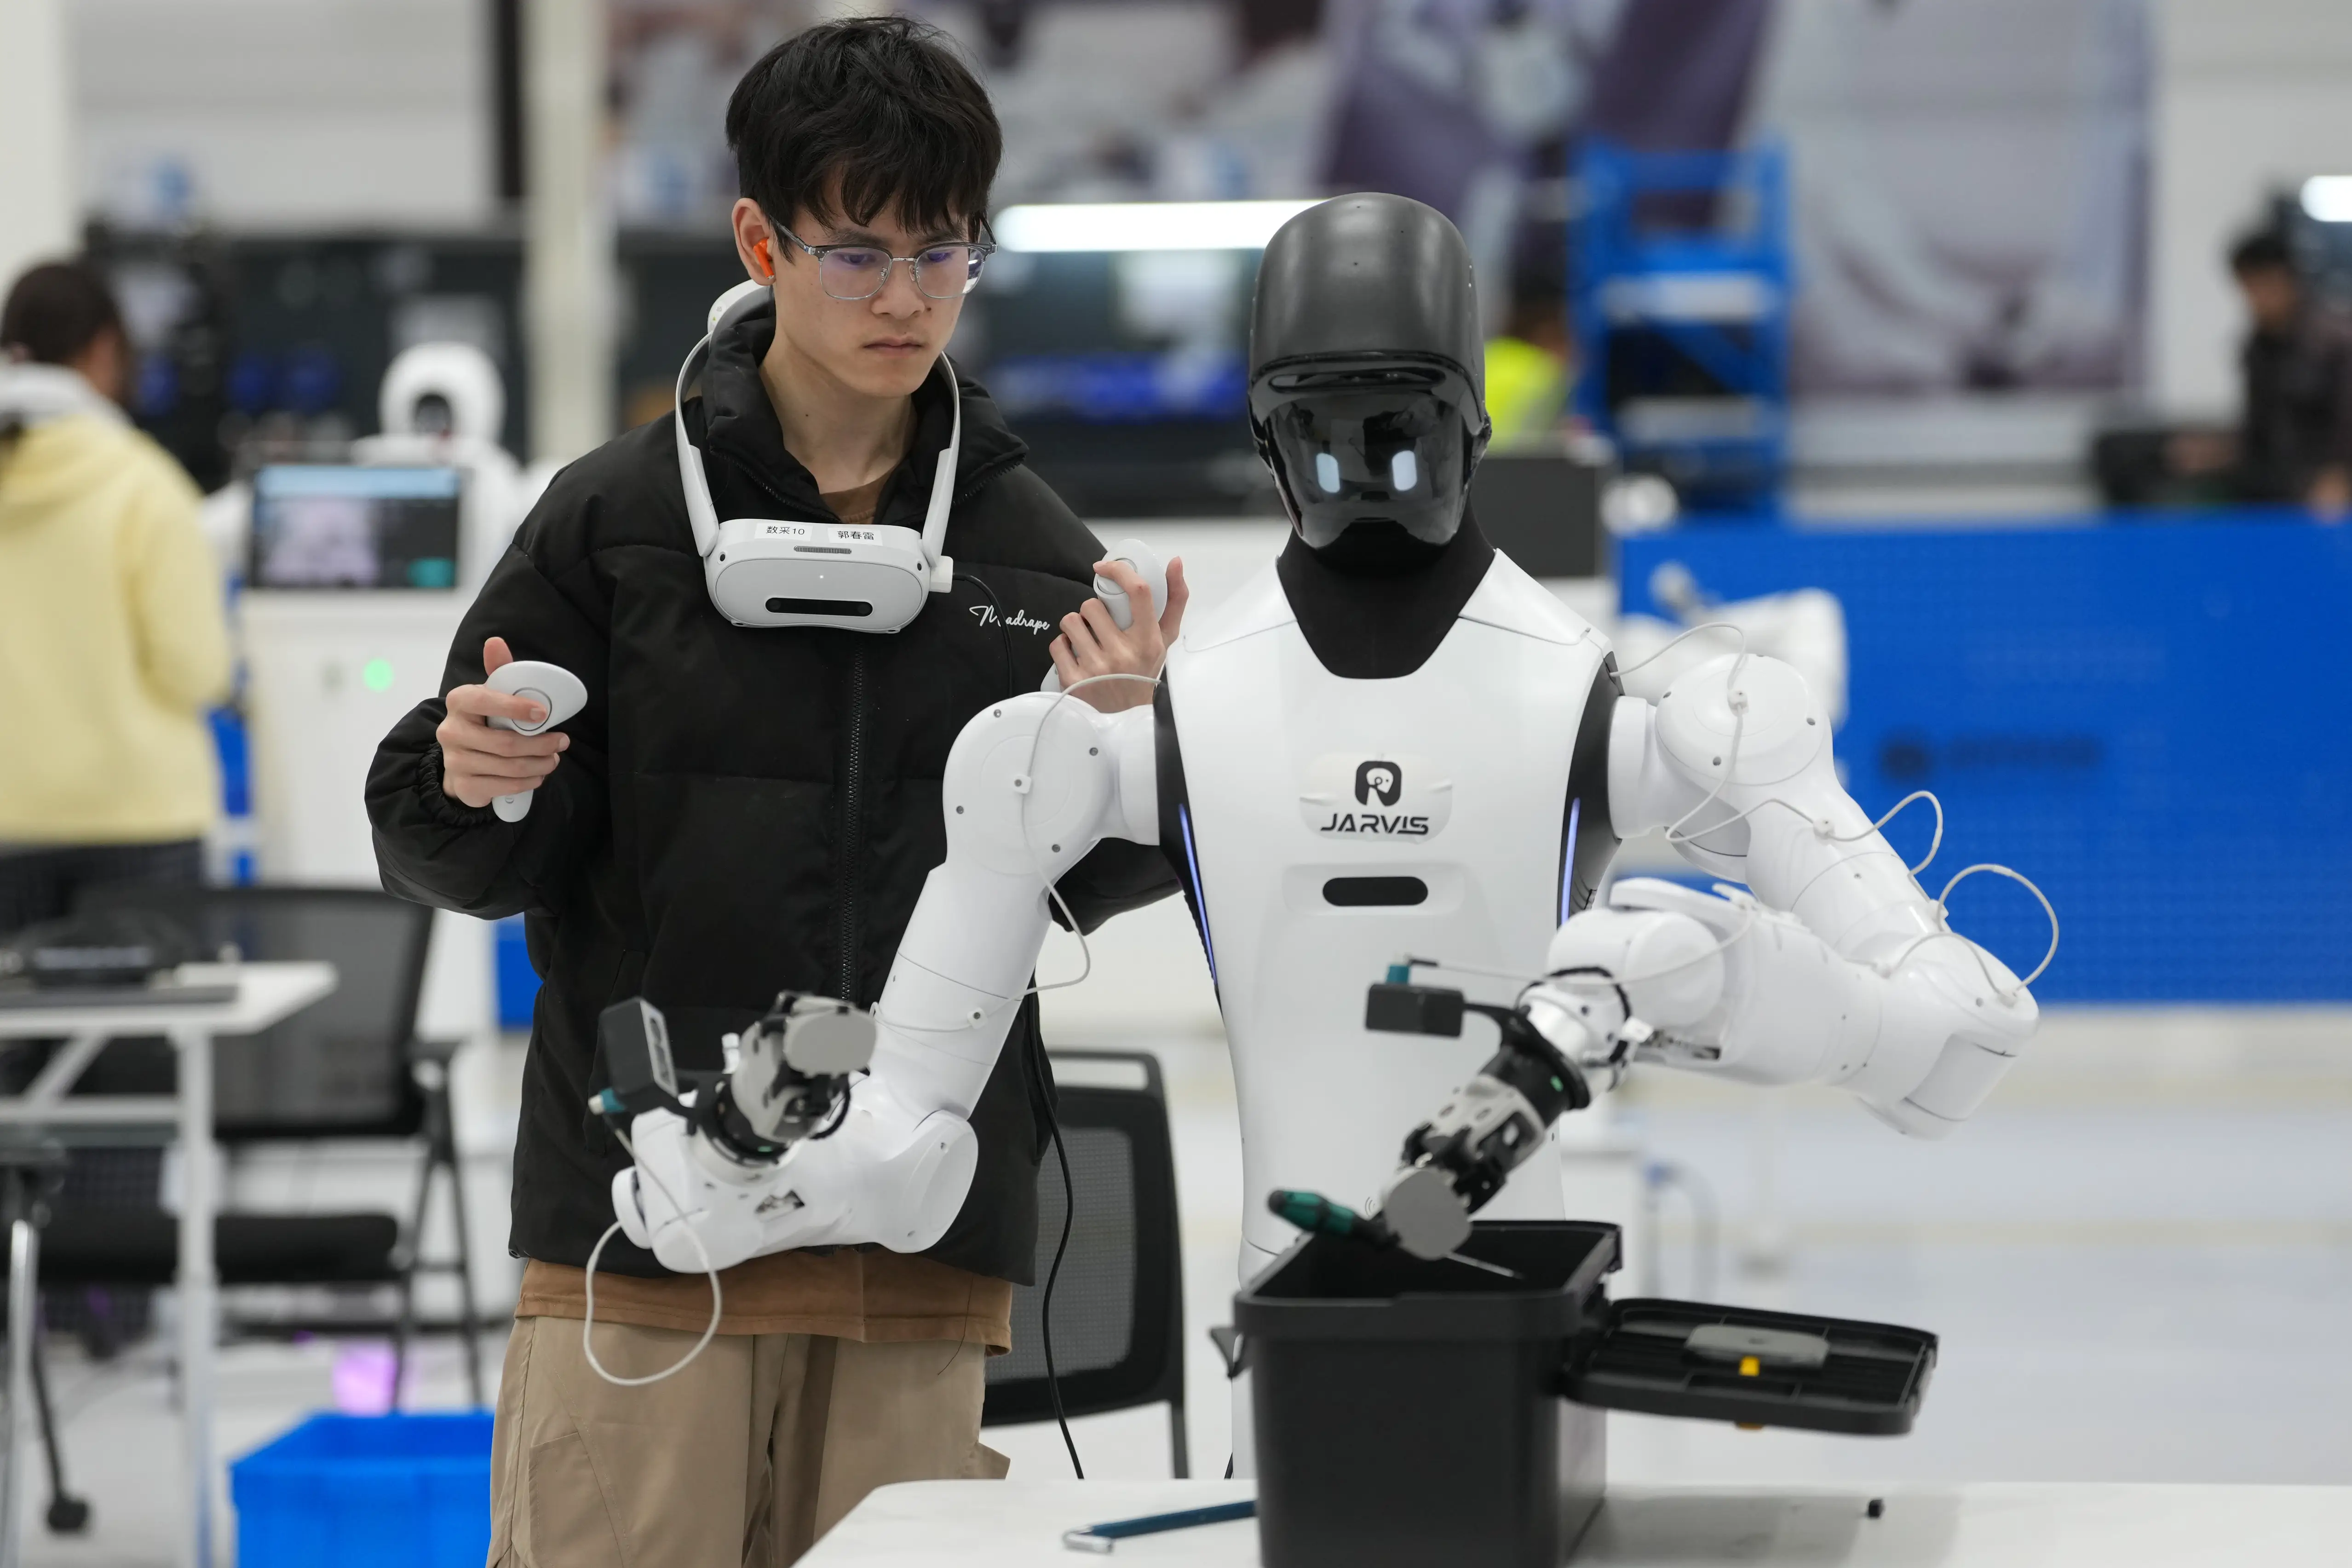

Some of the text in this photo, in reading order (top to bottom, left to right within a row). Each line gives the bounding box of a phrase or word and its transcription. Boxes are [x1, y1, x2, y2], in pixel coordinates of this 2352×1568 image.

[765, 526, 805, 535] 数采10
[837, 530, 874, 540] 郭春雷
[1320, 813, 1429, 835] JARVIS
